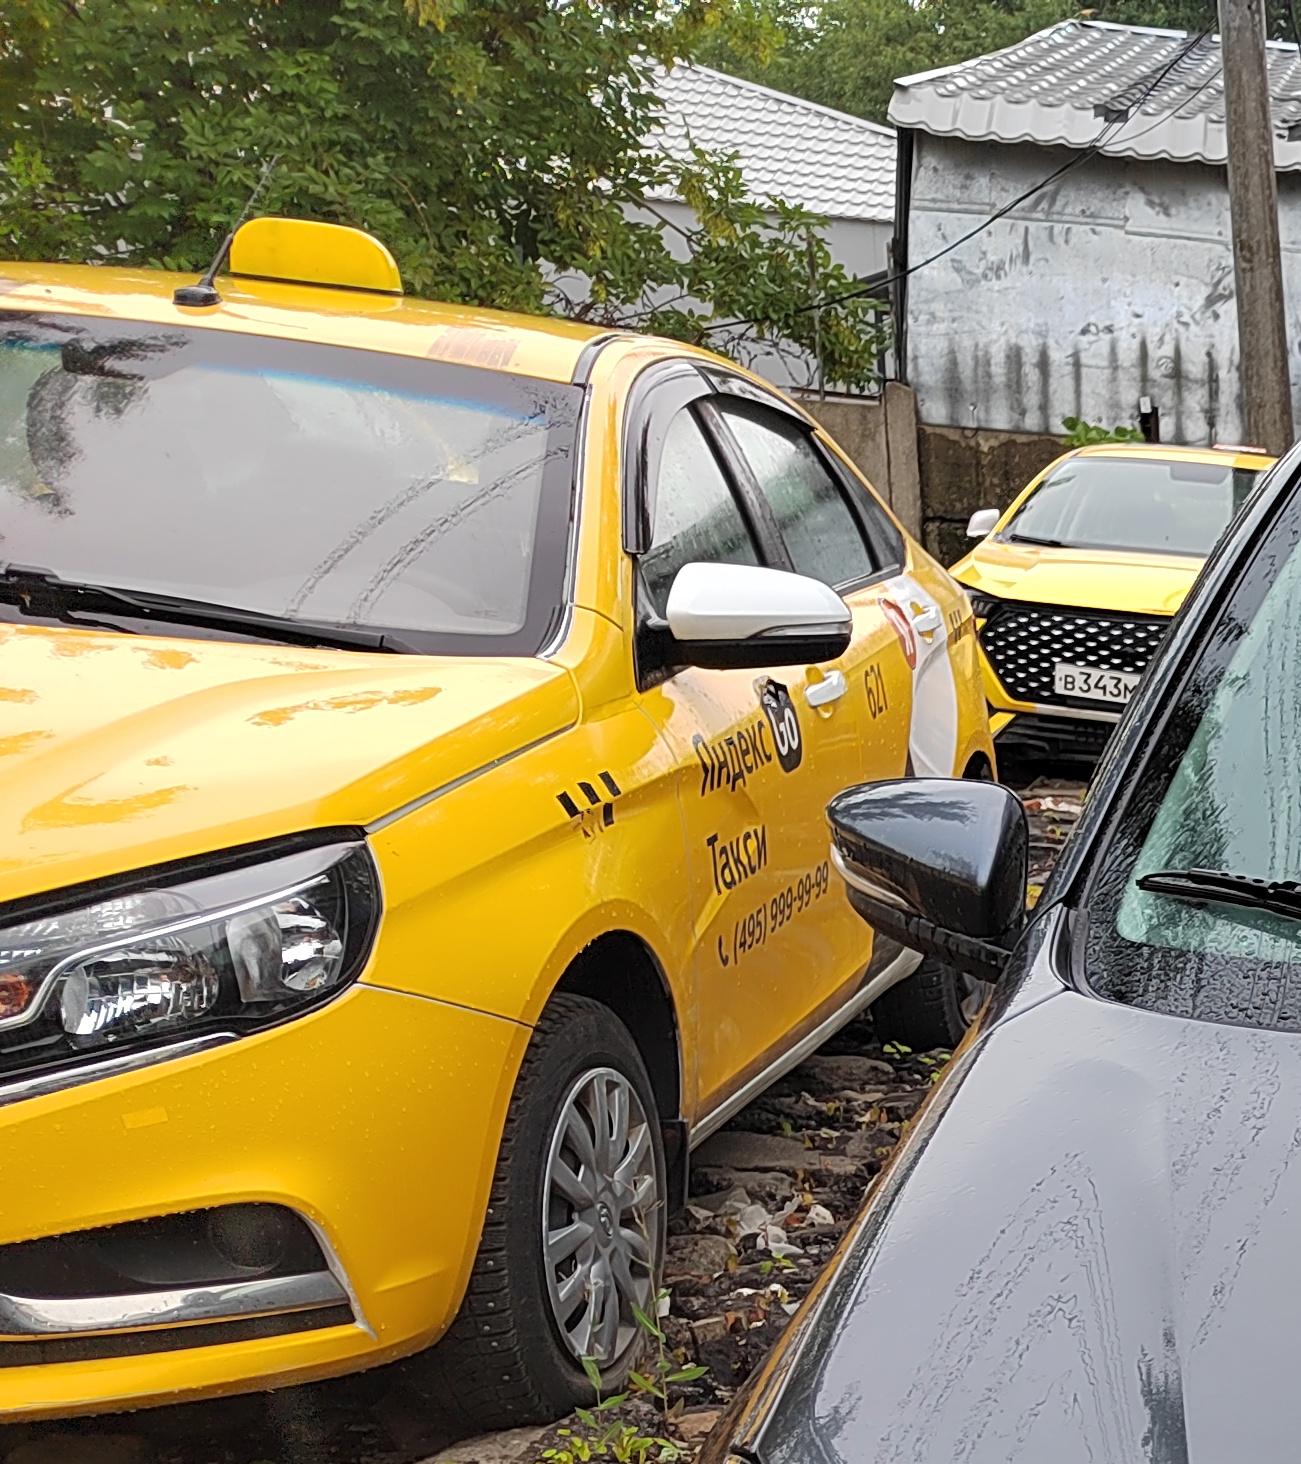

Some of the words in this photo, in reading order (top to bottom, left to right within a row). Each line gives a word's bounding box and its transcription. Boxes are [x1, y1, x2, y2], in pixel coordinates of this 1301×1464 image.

[864, 662, 889, 720] 621
[692, 719, 772, 797] Яндекс
[706, 824, 768, 895] Такси
[733, 903, 768, 965] (495)
[770, 860, 829, 934] 999-99-99
